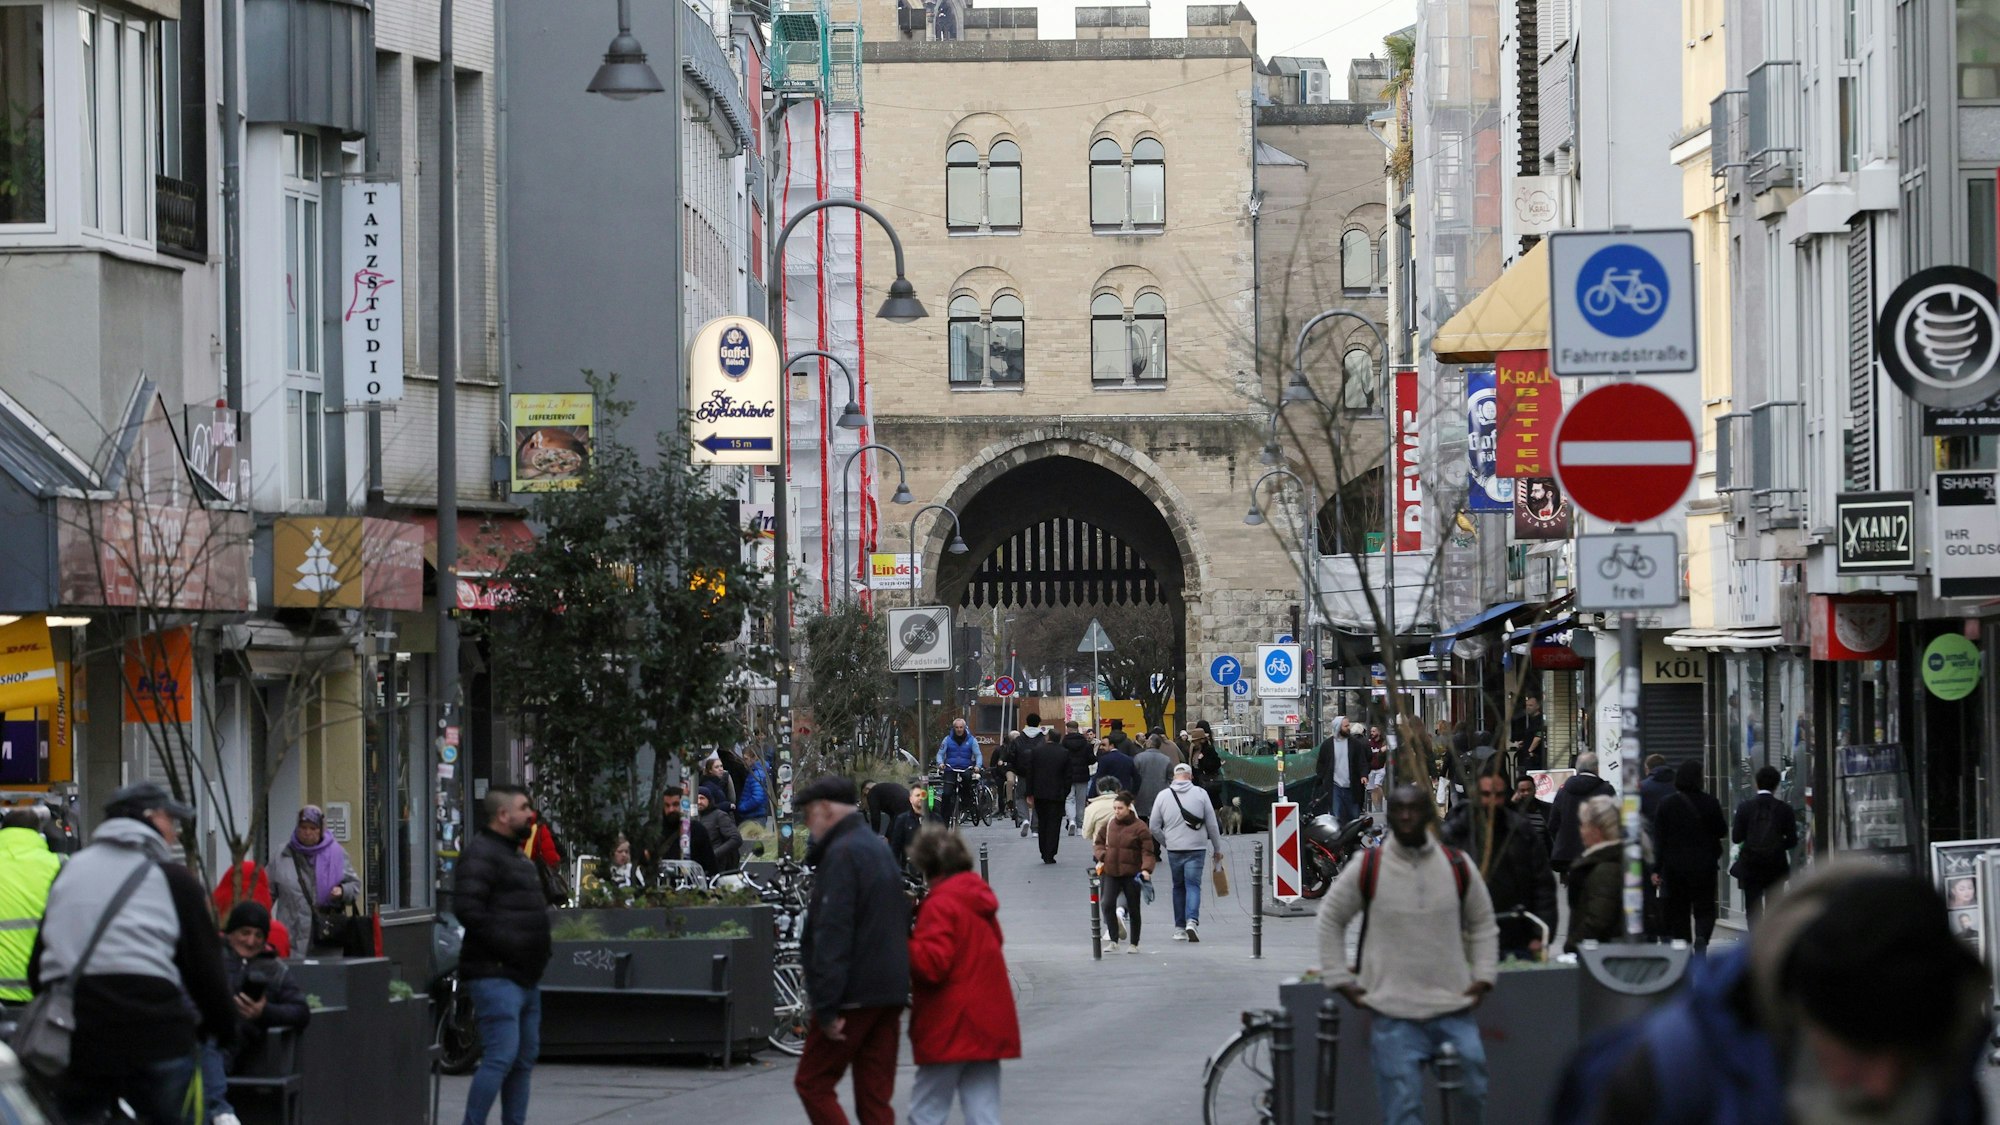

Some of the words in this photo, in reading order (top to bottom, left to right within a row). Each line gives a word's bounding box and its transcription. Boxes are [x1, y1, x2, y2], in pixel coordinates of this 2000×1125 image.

[364, 191, 380, 395] TANZSTUDIO
[721, 346, 750, 359] Gaffel
[1562, 346, 1687, 365] Fahrradstraße
[1500, 366, 1553, 384] KRALL
[528, 413, 576, 421] LIEFERSERVICE
[696, 400, 775, 423] Eigelschänke
[1515, 387, 1540, 474] BETTEN
[730, 440, 741, 448] 15
[1522, 511, 1566, 528] CLASSIC
[1945, 529, 1970, 540] IHR
[1946, 543, 2000, 556] GOLDS
[872, 563, 919, 576] Linden
[1612, 583, 1645, 599] frei
[6, 643, 39, 654] DHL
